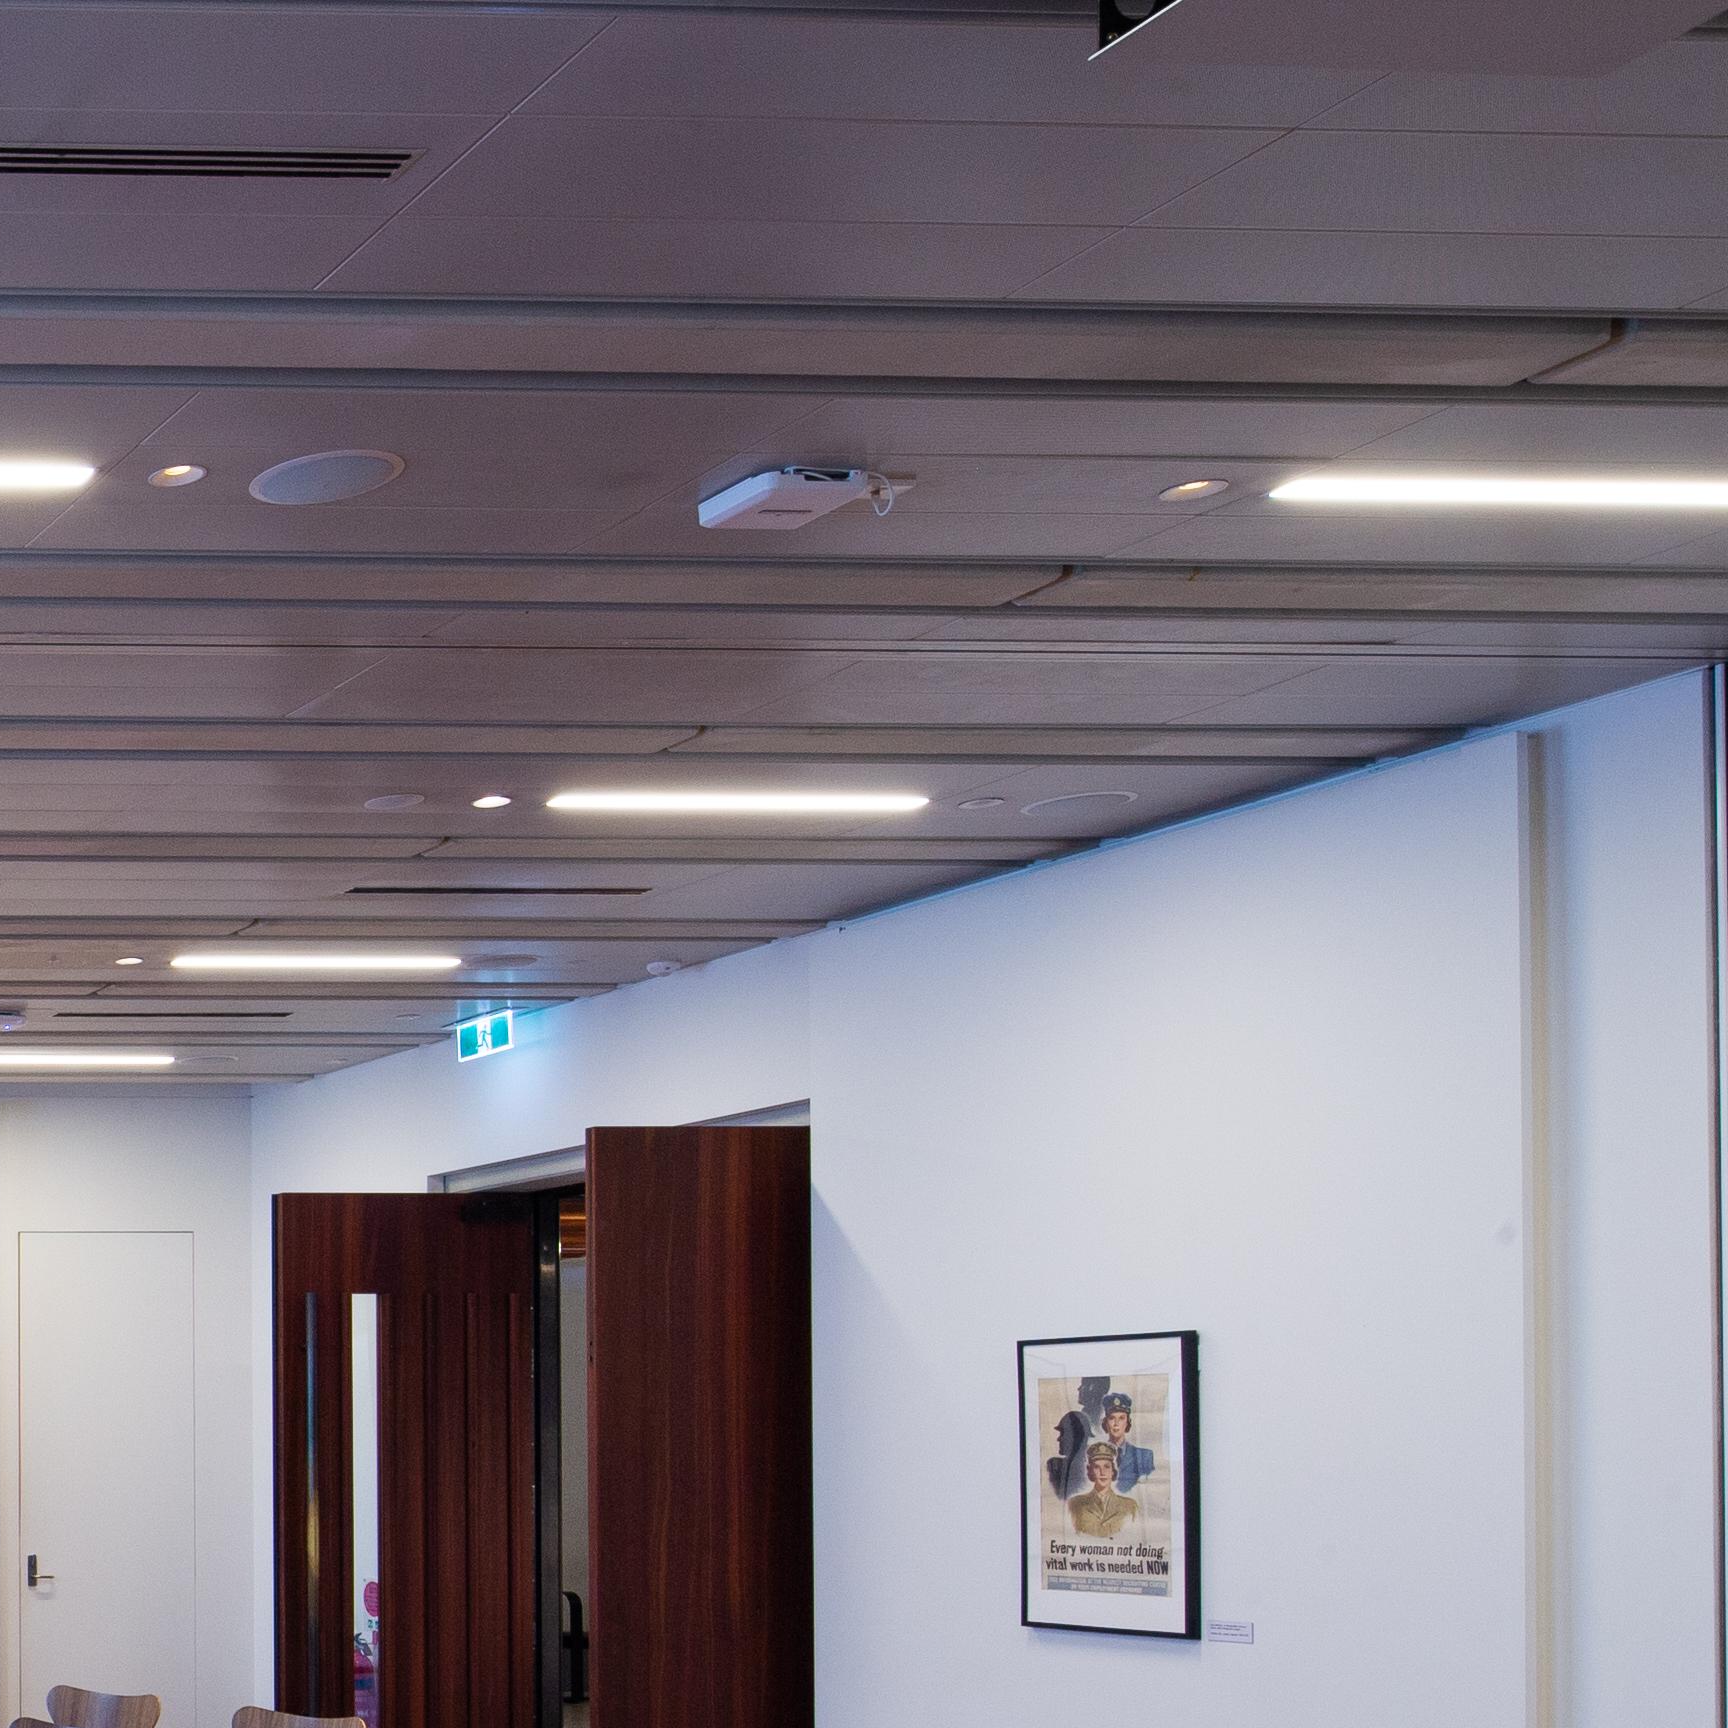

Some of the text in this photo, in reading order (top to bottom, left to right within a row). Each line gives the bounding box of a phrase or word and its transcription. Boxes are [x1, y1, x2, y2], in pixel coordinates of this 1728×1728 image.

[1050, 1540, 1077, 1556] Every
[1079, 1545, 1114, 1556] woman
[1116, 1543, 1132, 1557] not
[1046, 1558, 1169, 1576] vital work is needed NOW
